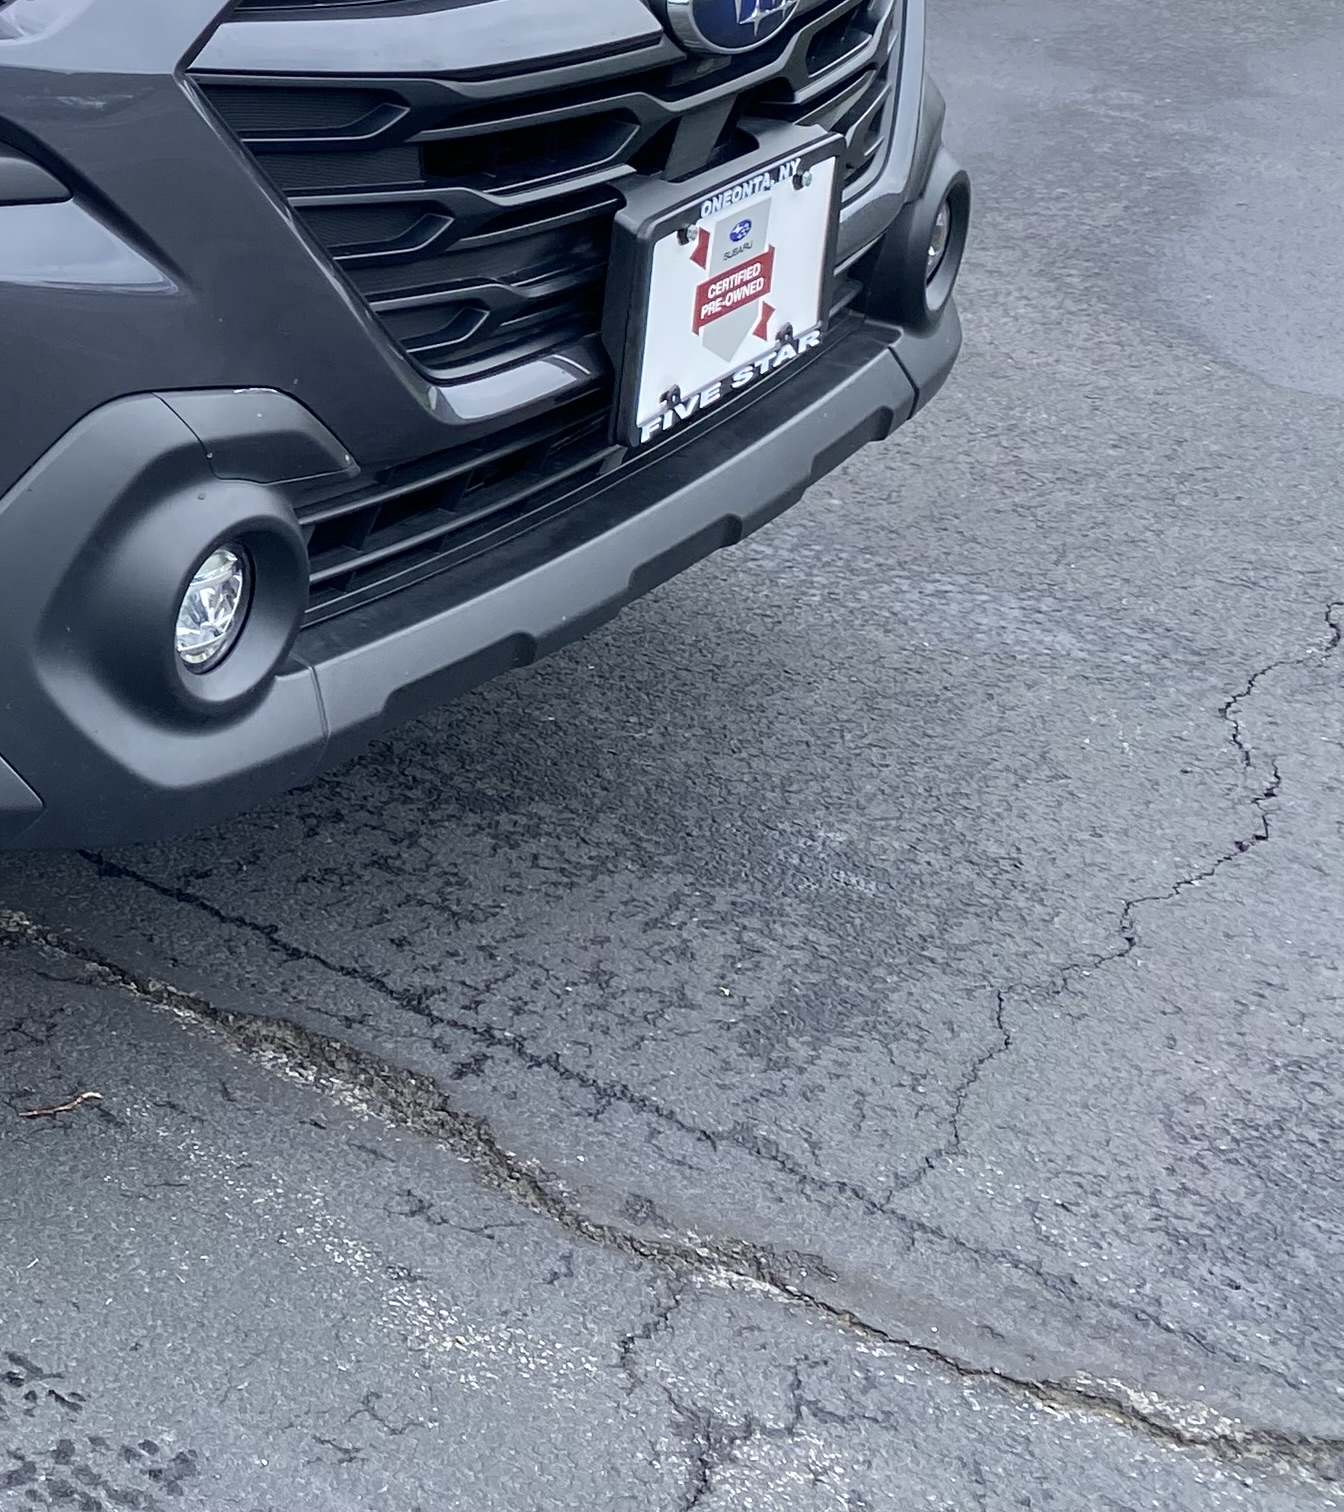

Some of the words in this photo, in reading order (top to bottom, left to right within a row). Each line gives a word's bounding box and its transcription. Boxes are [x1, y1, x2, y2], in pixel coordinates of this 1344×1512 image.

[778, 159, 801, 183] NY
[723, 242, 753, 261] SUBARU
[700, 277, 765, 320] PRE-OWNED
[708, 263, 762, 299] CERTIFIED
[639, 381, 722, 443] FIVE
[731, 330, 821, 389] STAR
